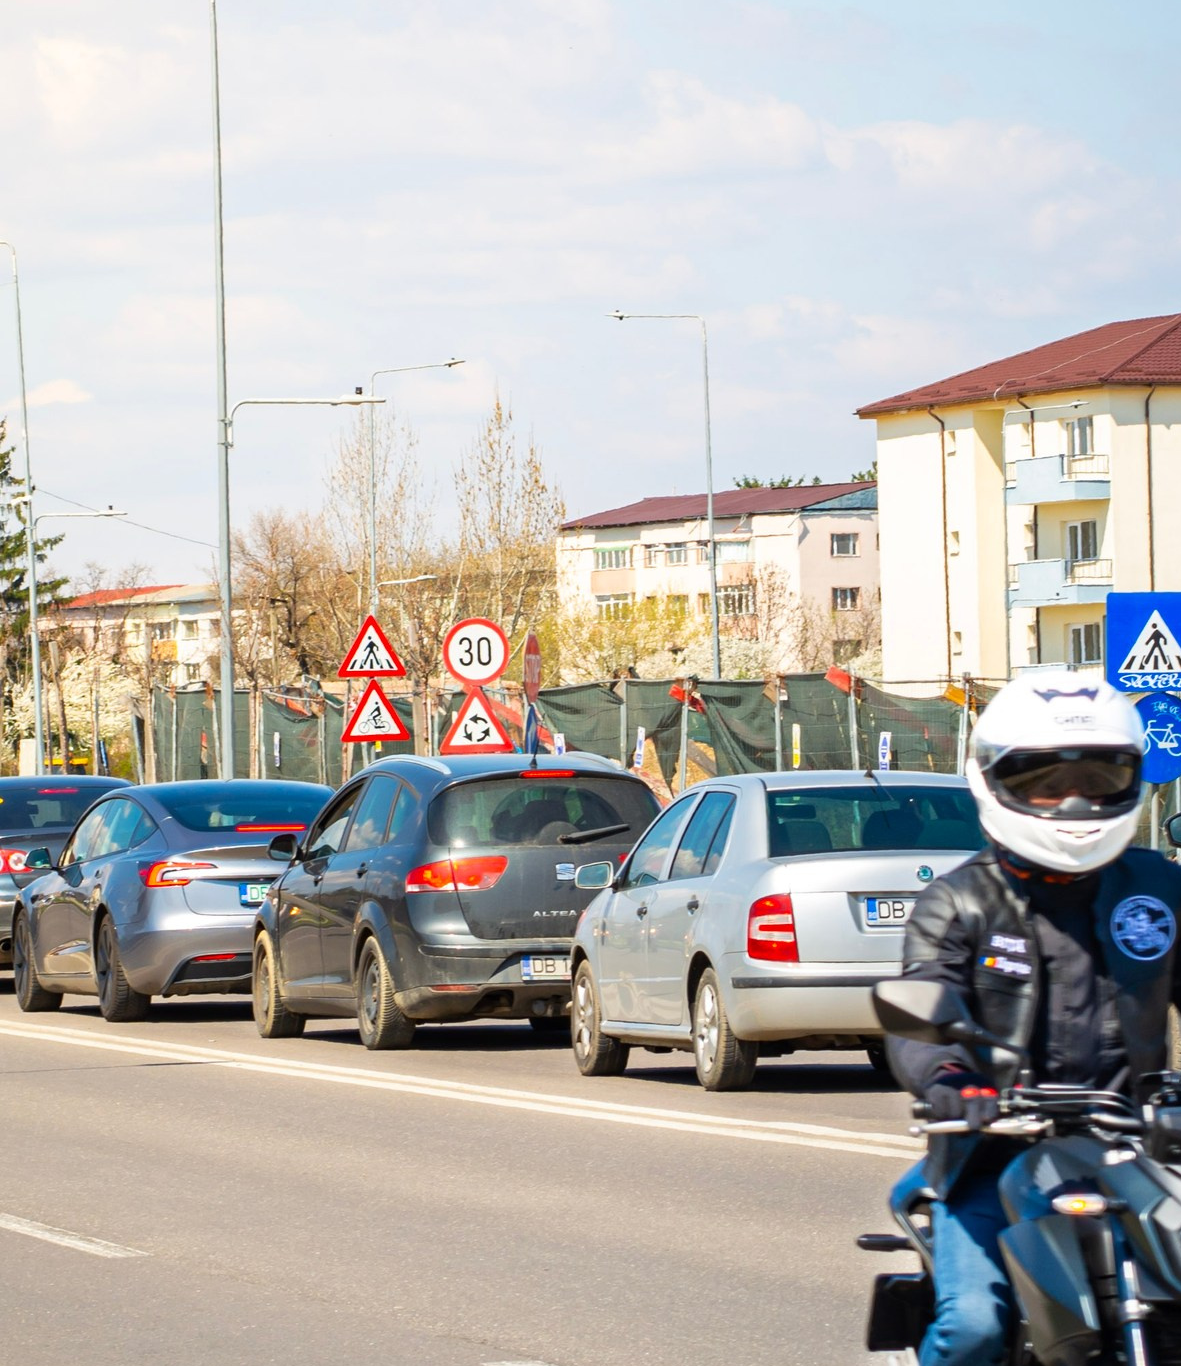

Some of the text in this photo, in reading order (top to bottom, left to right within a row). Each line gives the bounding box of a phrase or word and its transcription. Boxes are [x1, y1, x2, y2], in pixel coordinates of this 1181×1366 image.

[459, 637, 492, 666] 30
[878, 900, 905, 919] DB
[532, 957, 556, 973] DB
